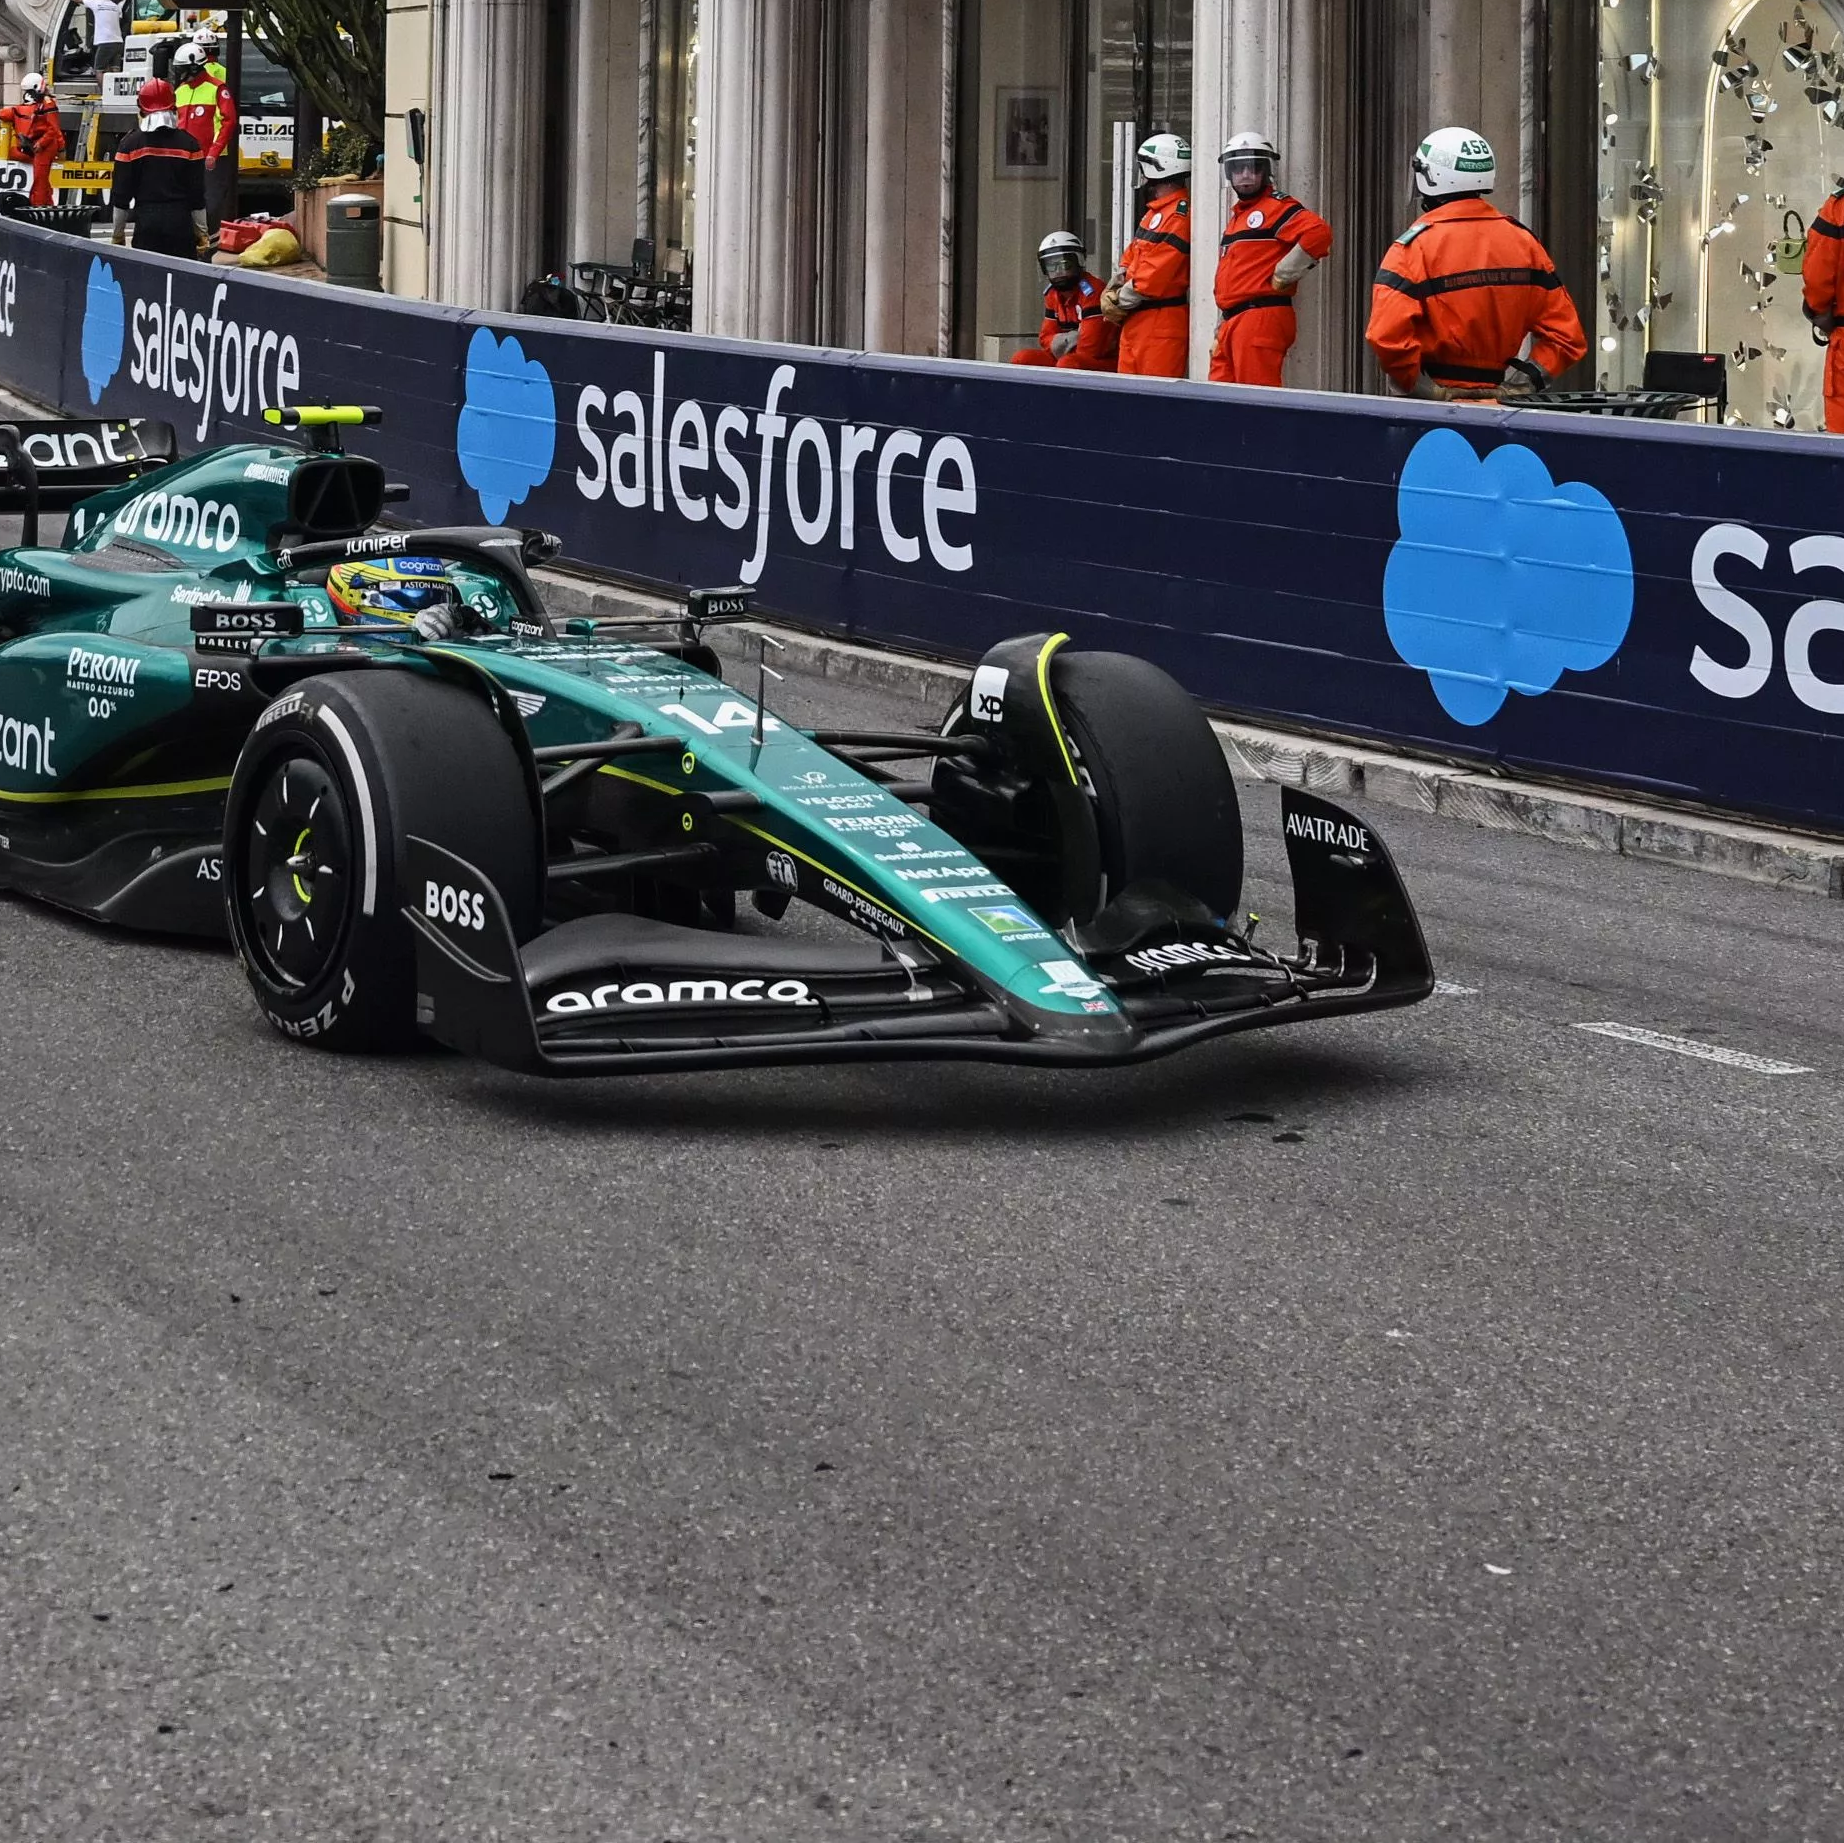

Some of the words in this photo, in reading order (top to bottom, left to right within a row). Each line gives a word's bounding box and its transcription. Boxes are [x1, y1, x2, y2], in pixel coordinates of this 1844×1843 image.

[1460, 140, 1490, 156] 458
[129, 273, 301, 443] salesforce
[575, 351, 978, 584] salesforce
[114, 491, 240, 553] aramco
[404, 581, 431, 589] ASTON
[707, 597, 745, 615] BOSS
[216, 612, 277, 629] BOSS
[510, 620, 545, 637] cognizant
[67, 647, 141, 685] PERONI
[66, 680, 96, 692] NASTRO
[97, 683, 136, 698] AZZURRO
[658, 701, 782, 735] 14
[796, 793, 886, 805] VELOCITY
[827, 801, 876, 811] BLACK
[823, 814, 923, 829] PERONI
[1285, 812, 1371, 852] AVATRADE
[767, 858, 796, 889] FIA
[894, 865, 992, 881] NetApp
[425, 880, 485, 931] BOSS
[823, 877, 906, 937] GIRARD-PERREGAUX
[1001, 931, 1052, 942] aramco
[545, 979, 811, 1013] aramco
